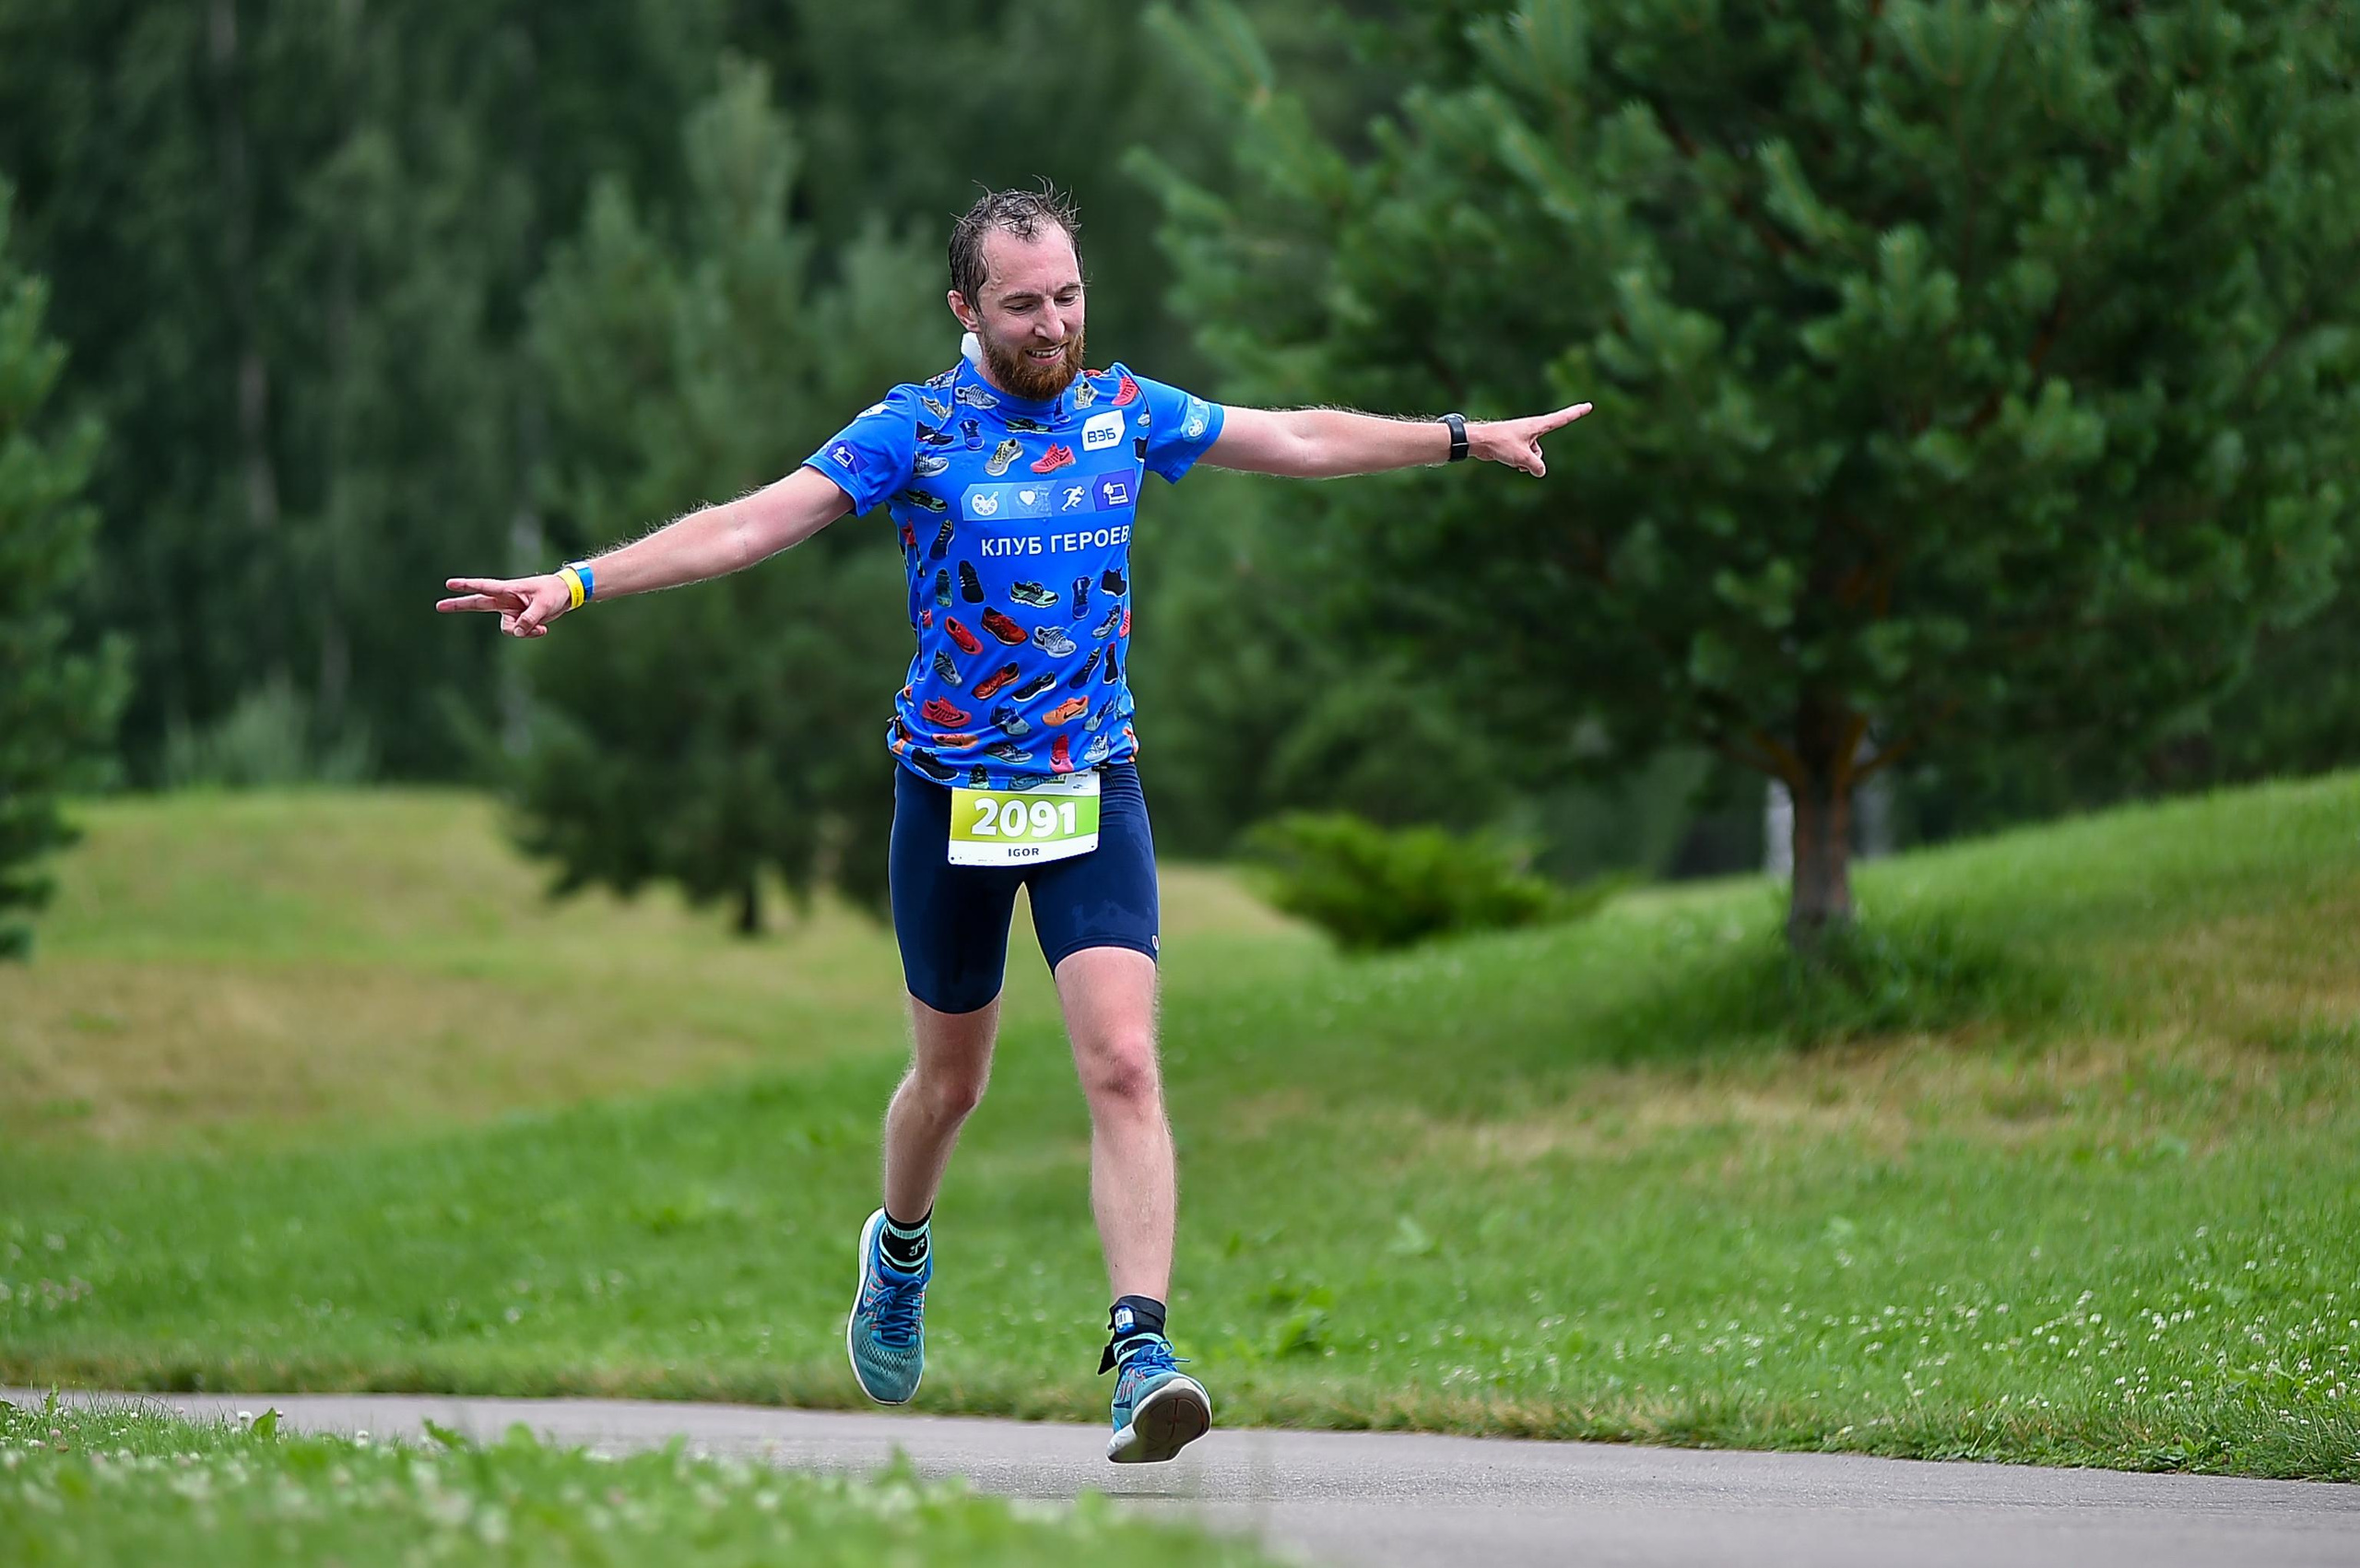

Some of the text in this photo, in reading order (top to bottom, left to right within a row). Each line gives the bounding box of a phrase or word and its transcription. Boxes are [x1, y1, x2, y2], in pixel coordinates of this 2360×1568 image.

[1087, 428, 1116, 443] ВЭБ
[981, 525, 1131, 557] КЛУБ ГЕРОЕВ
[971, 797, 1077, 839] 2091
[1008, 847, 1040, 857] IGOR
